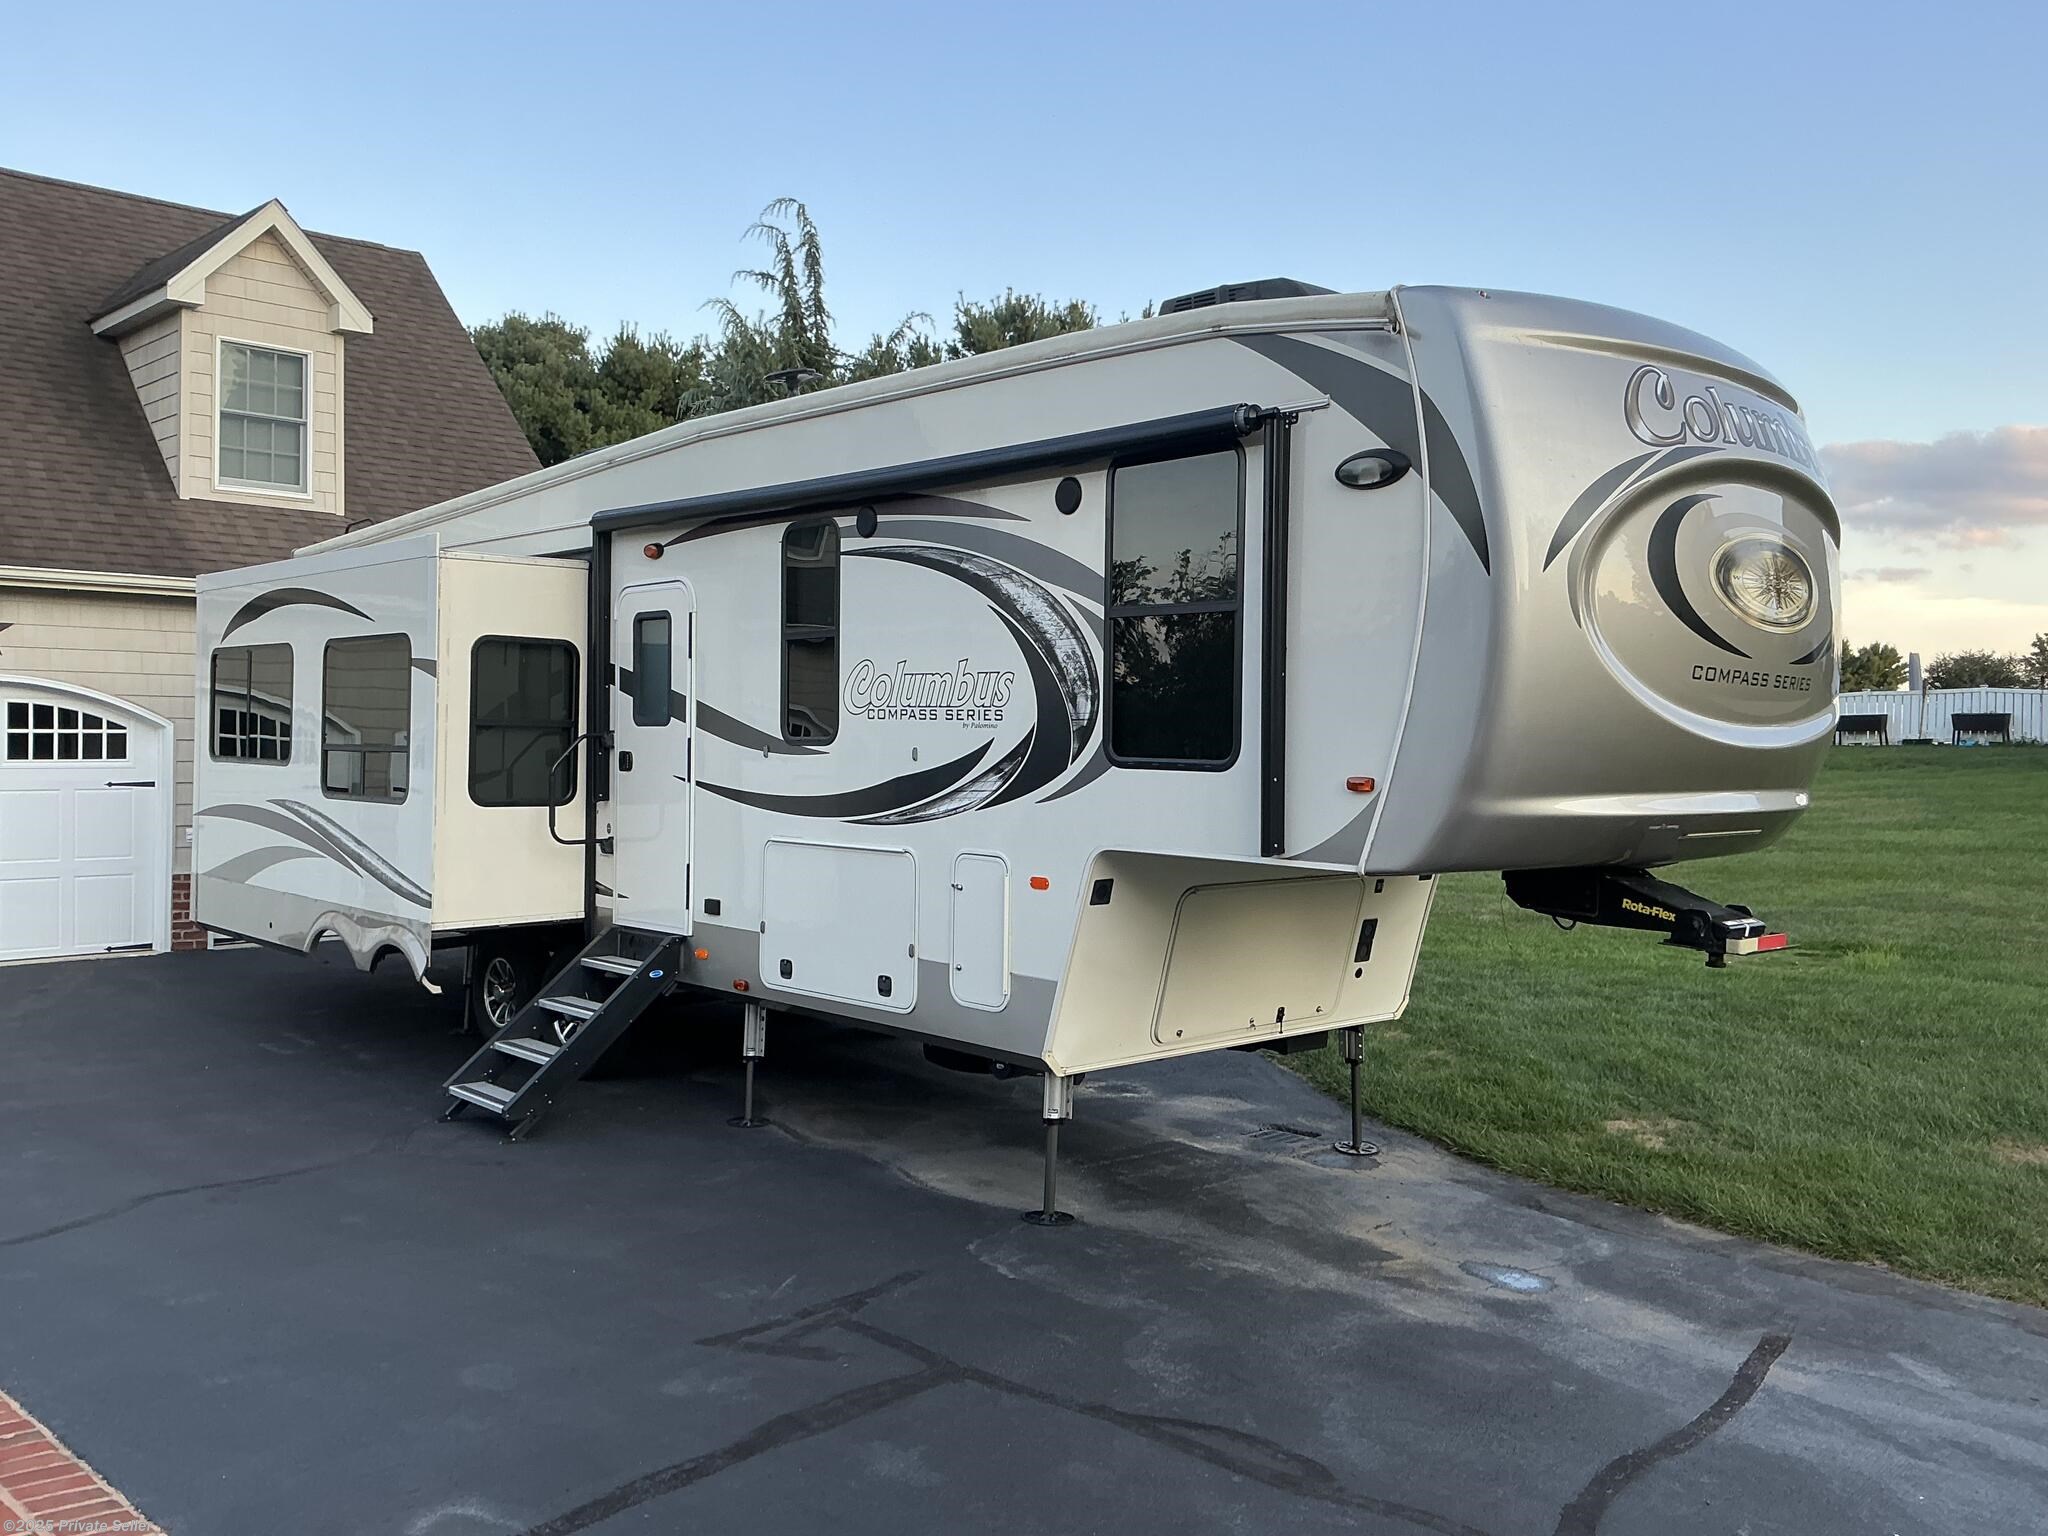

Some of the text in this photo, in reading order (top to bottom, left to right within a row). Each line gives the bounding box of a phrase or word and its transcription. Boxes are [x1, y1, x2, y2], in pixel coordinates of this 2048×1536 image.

[843, 658, 1015, 715] Columbus
[1692, 665, 1812, 692] COMPASS SERIES
[867, 708, 1004, 721] COMPASS SERIES
